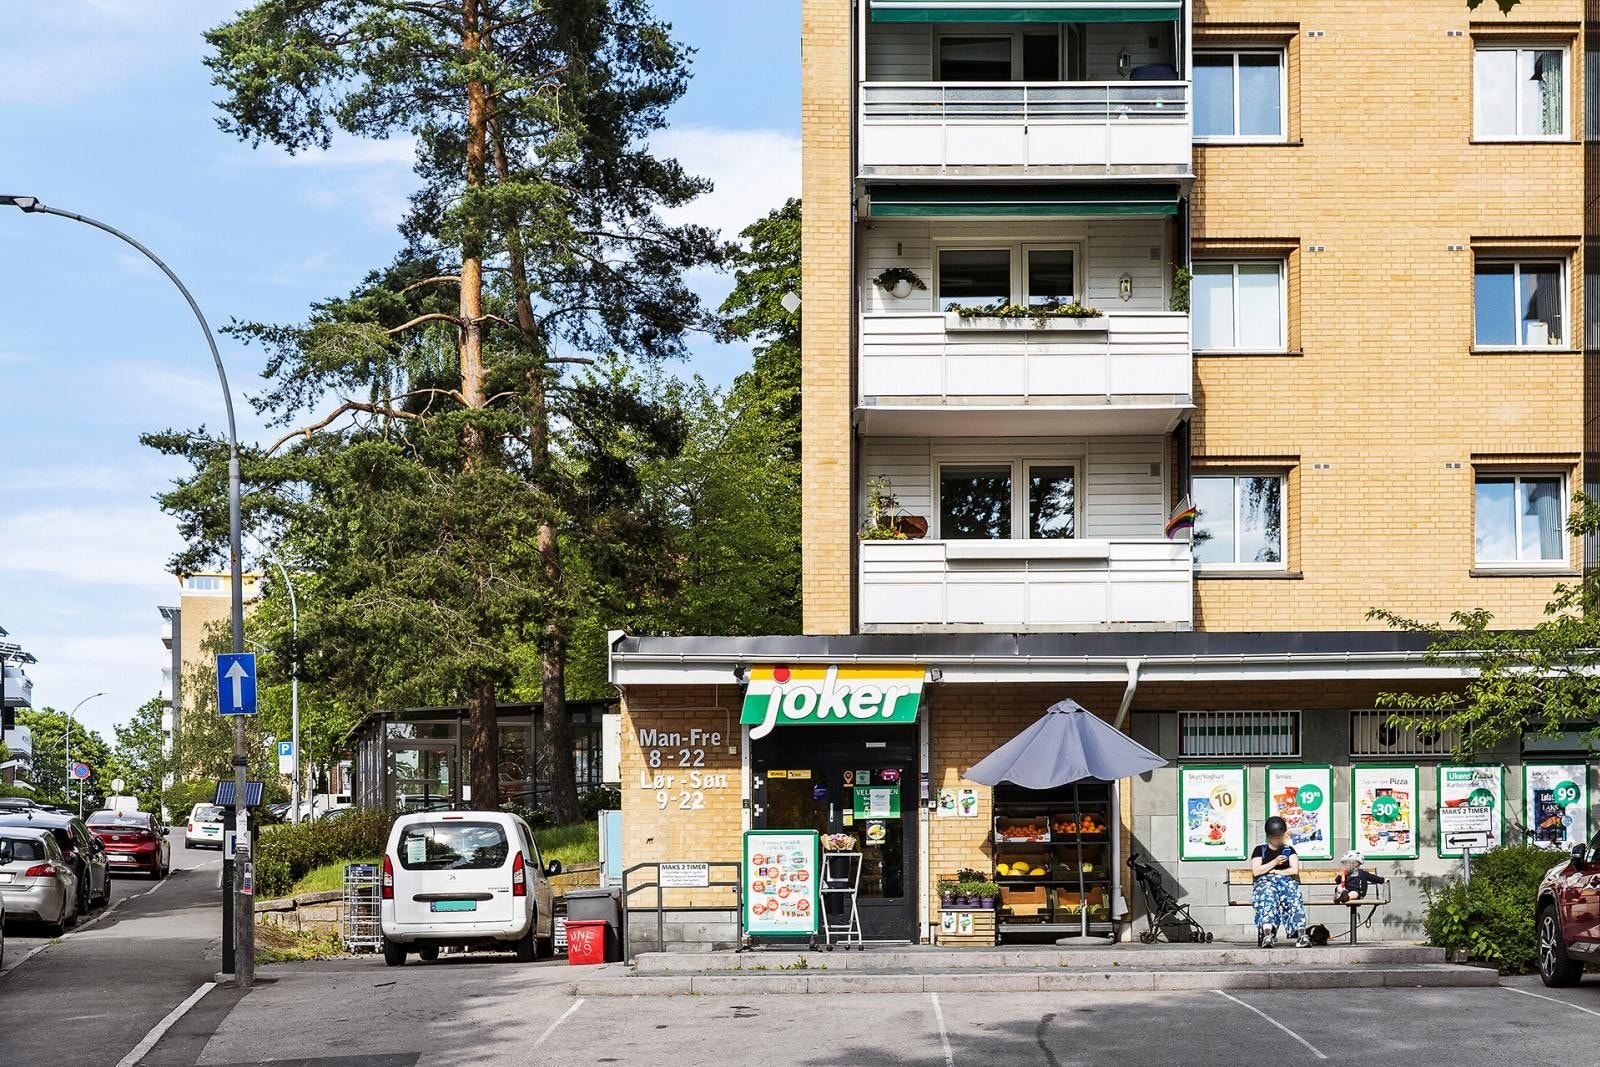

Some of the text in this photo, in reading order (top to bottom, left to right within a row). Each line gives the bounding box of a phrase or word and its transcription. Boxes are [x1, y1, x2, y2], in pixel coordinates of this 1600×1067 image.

[749, 665, 911, 741] joker
[640, 728, 721, 747] Man-Fre
[281, 743, 290, 755] P
[1389, 777, 1408, 785] Pizza
[1214, 792, 1232, 807] 10
[1557, 788, 1576, 801] 99
